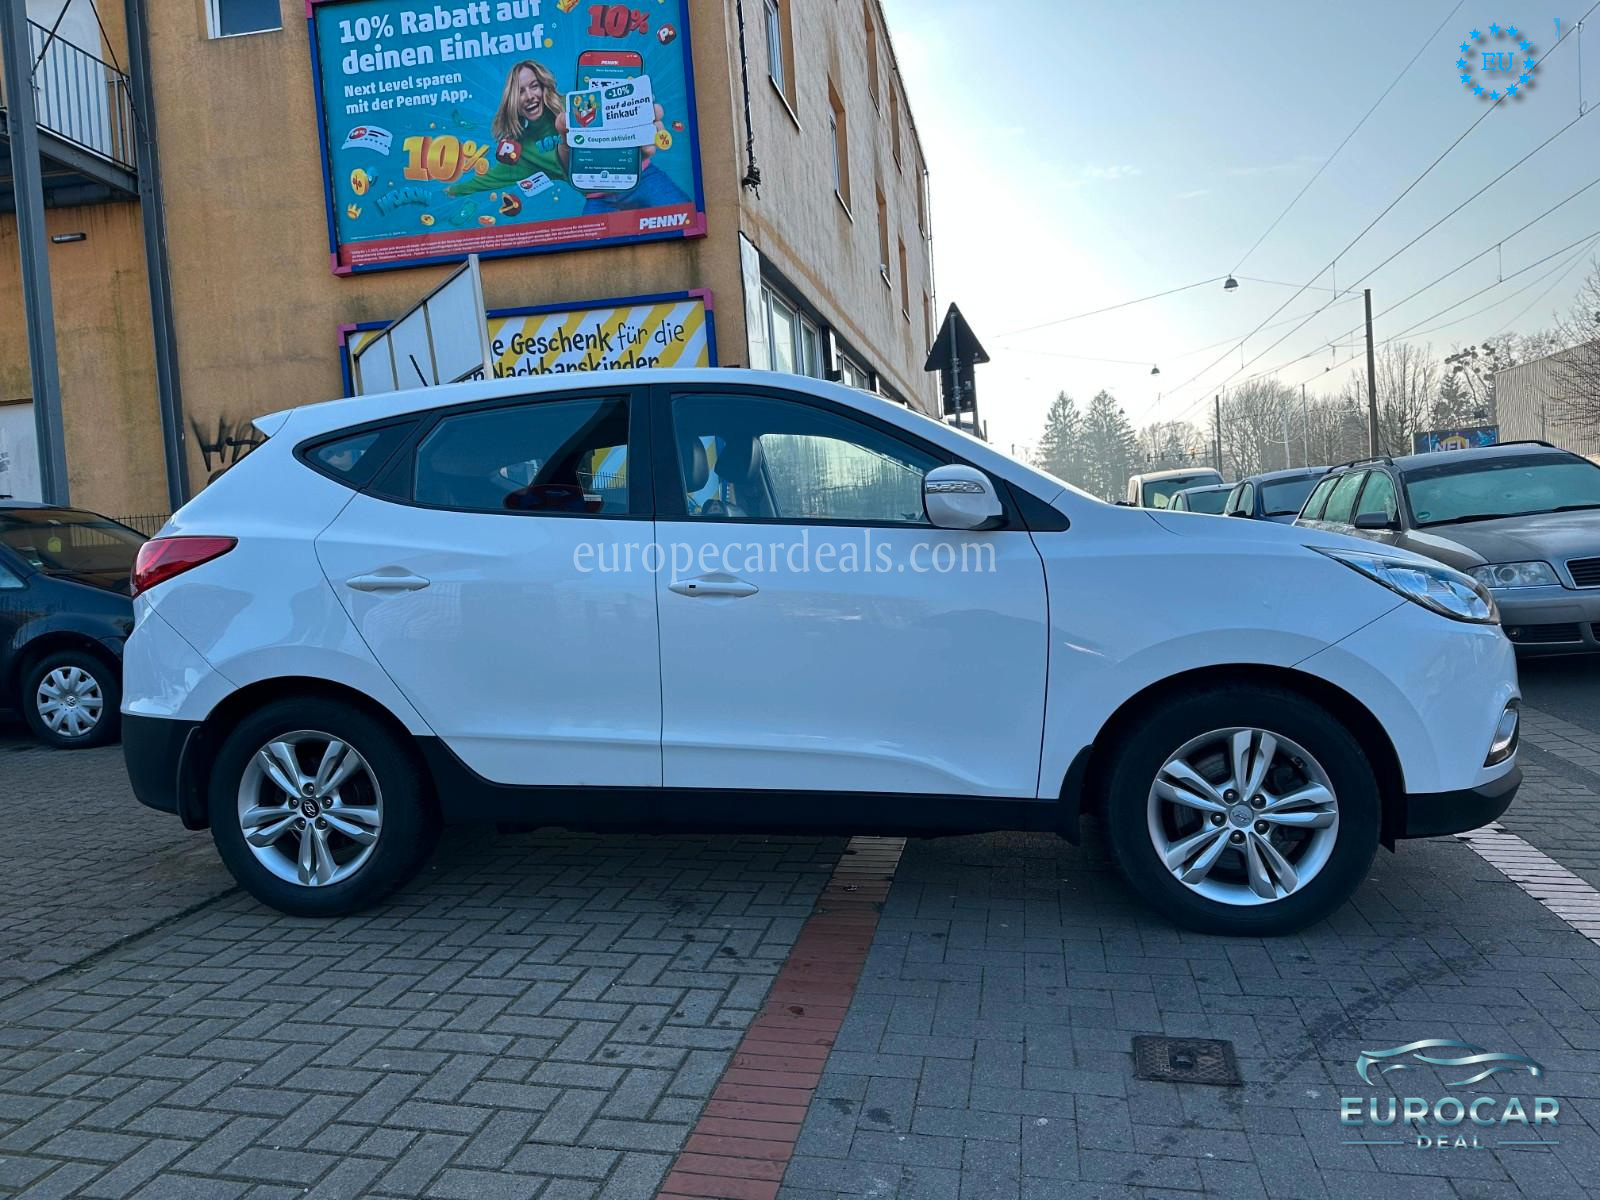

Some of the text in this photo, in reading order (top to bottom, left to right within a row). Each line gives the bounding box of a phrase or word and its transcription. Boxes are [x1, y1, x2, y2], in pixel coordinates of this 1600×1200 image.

[339, 0, 541, 44] 10% Rabatt auf
[588, 4, 650, 38] 10%
[342, 44, 434, 74] deinen
[344, 72, 462, 98] Next Level sparen
[346, 89, 472, 114] mit der Penny App.
[403, 135, 490, 182] 10%
[511, 324, 613, 355] Geschenk
[618, 322, 648, 350] für
[654, 320, 684, 346] die
